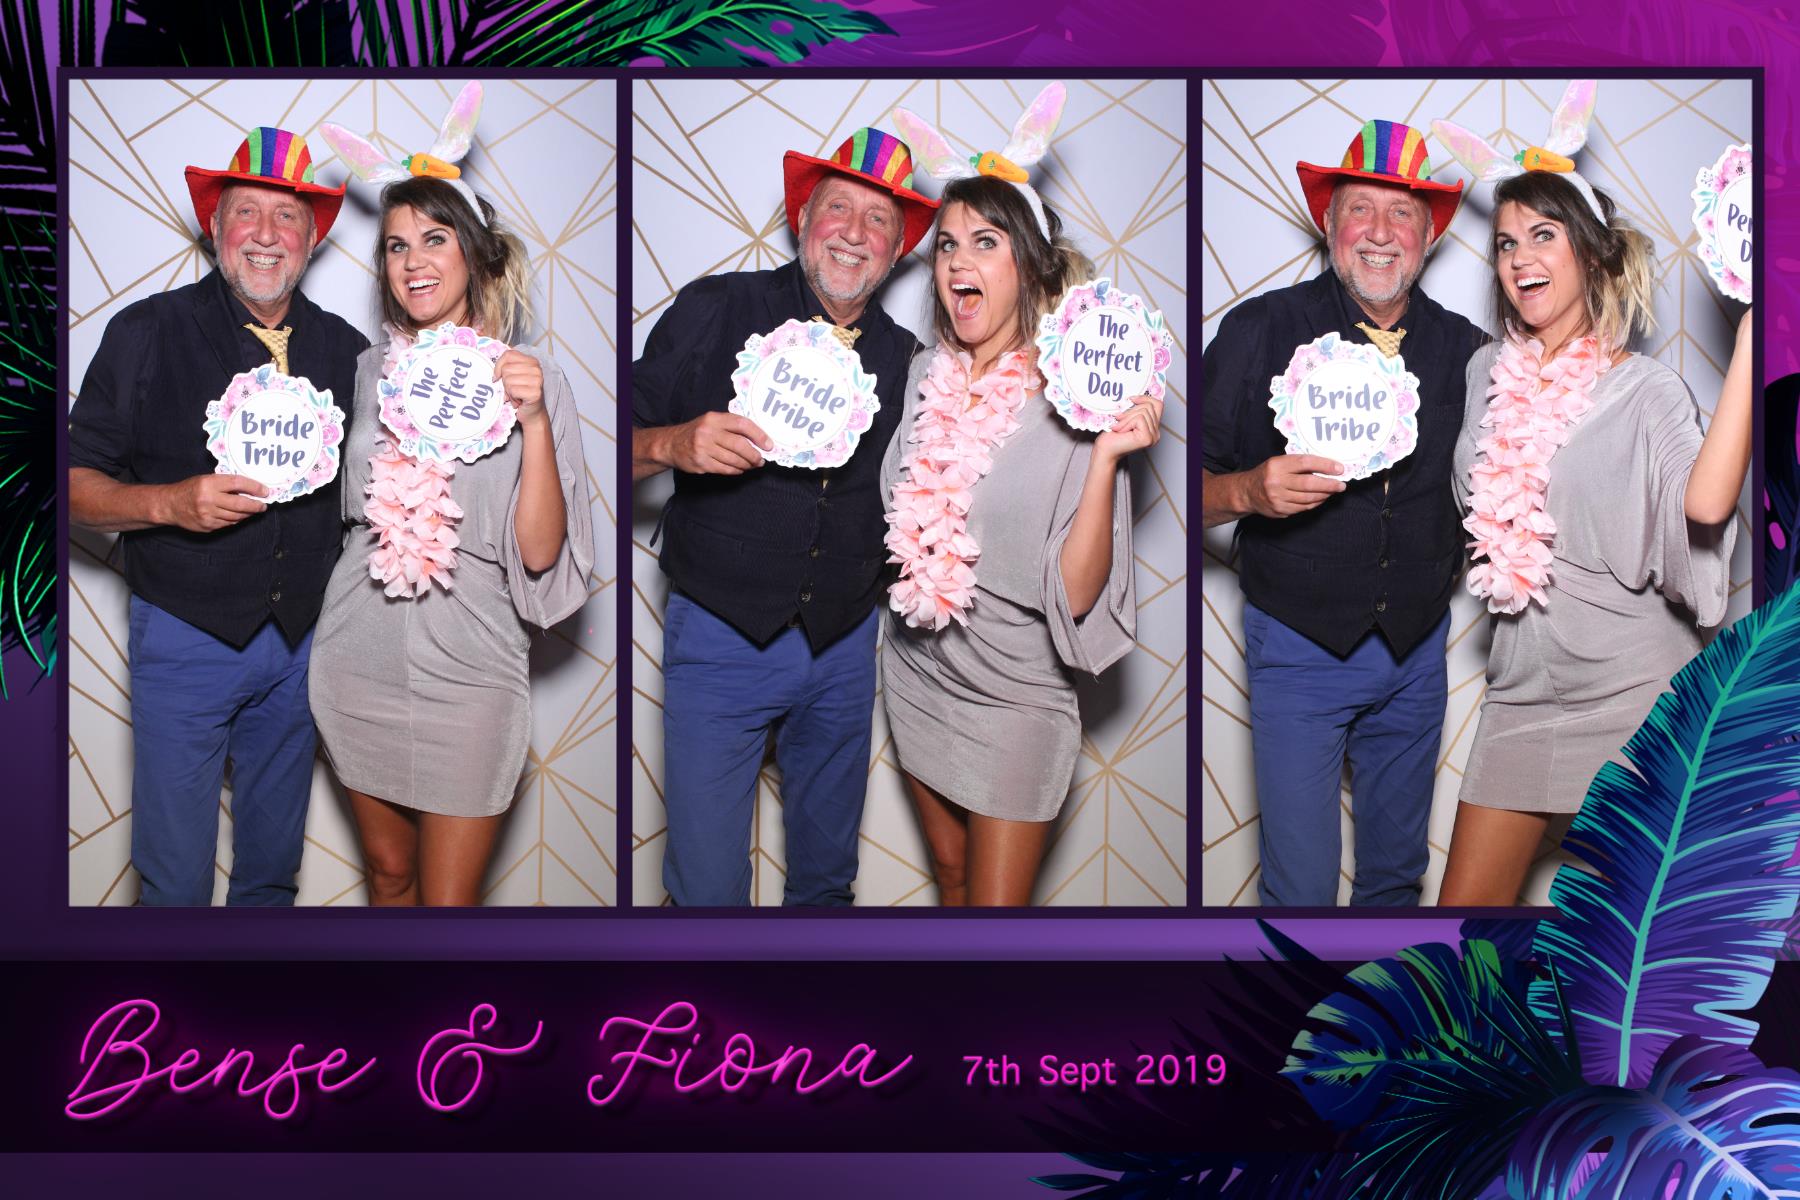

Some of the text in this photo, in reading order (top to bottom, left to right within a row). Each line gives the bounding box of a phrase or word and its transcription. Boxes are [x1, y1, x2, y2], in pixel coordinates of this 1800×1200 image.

[1098, 313, 1130, 341] The
[1072, 341, 1144, 374] Perfect
[409, 366, 439, 399] The
[428, 356, 473, 429] Perfect
[773, 357, 847, 415] Bride
[1087, 371, 1124, 401] Day
[1308, 383, 1387, 411] Bride
[460, 382, 495, 421] Day
[759, 386, 826, 439] Tribe
[241, 410, 315, 439] Bride
[1311, 416, 1381, 441] Tribe
[242, 441, 306, 468] Tribe
